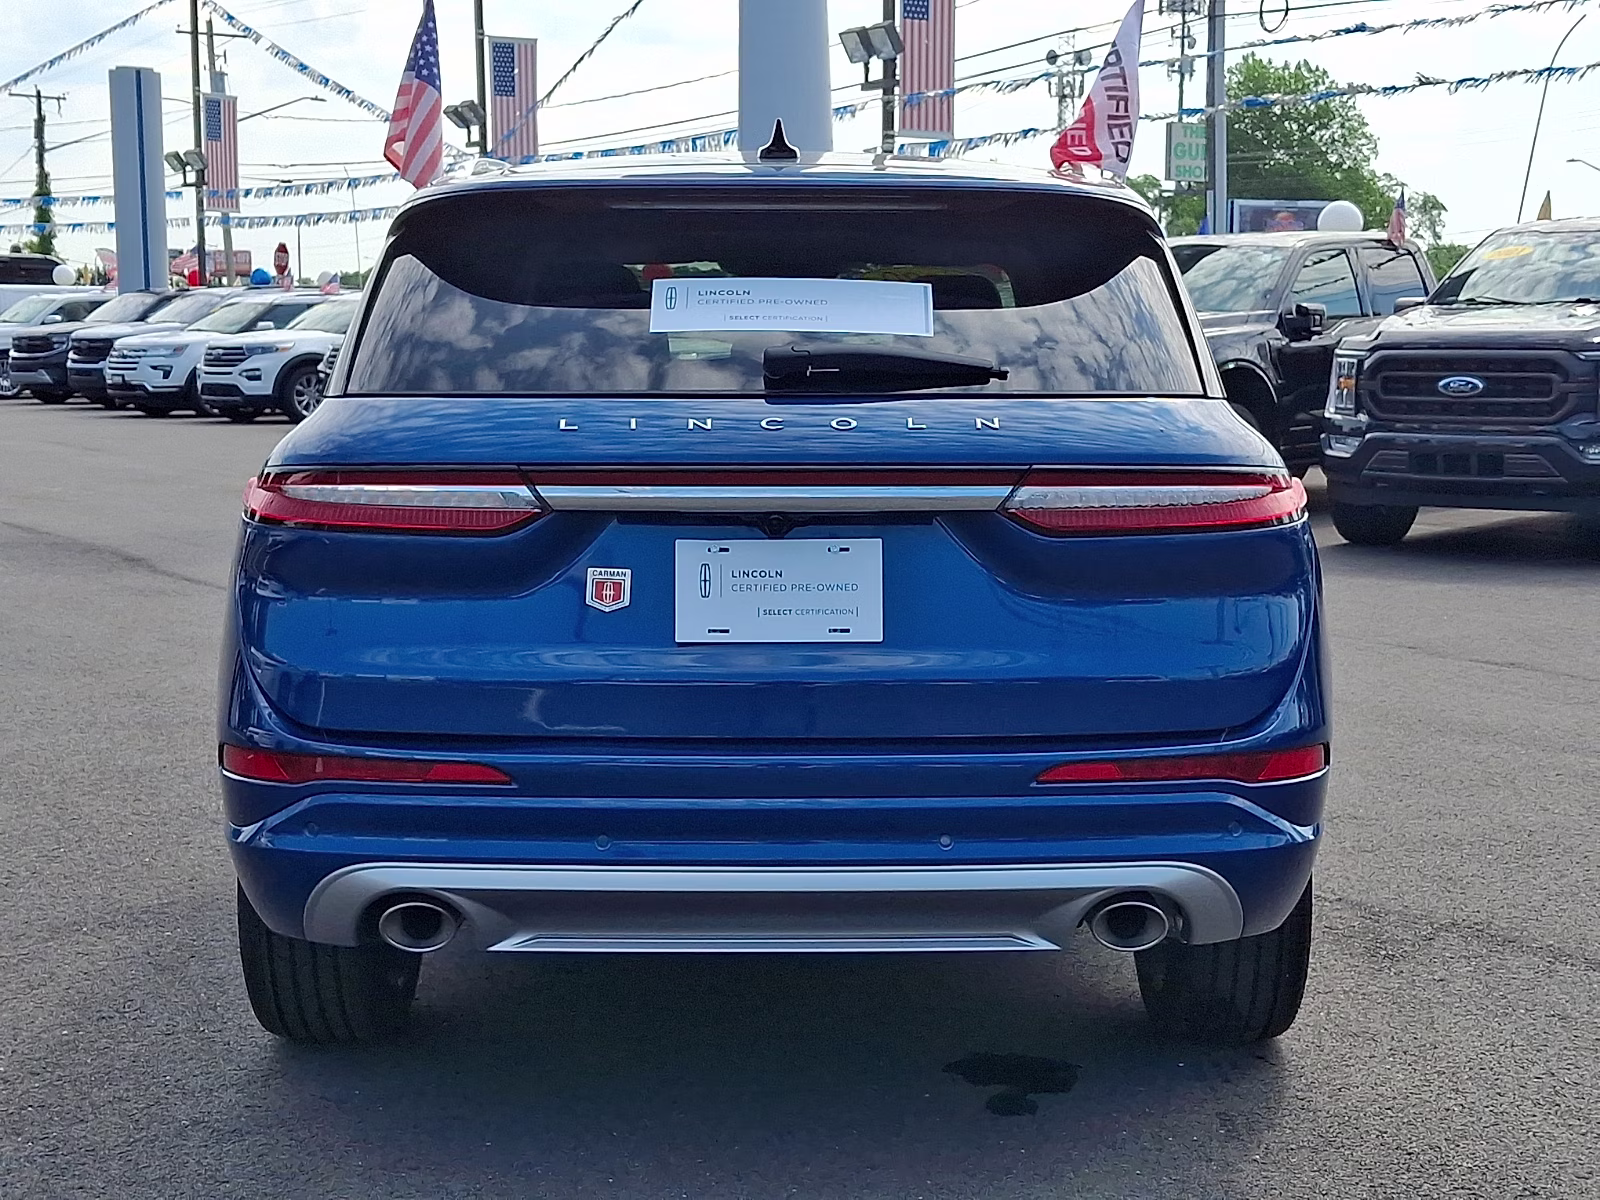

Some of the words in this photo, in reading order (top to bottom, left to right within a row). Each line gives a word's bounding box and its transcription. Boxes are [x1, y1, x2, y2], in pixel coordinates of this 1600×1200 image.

[1100, 40, 1132, 163] RTIFIED
[1175, 165, 1203, 179] SHO
[559, 417, 1000, 430] LINCOLN
[592, 569, 627, 577] CARMAN
[731, 569, 783, 578] LINCOLN
[731, 583, 787, 592] CERTIFIED
[790, 583, 859, 592] PRE-OWNED
[762, 608, 793, 616] SELECT
[794, 608, 854, 616] CERTIFICATION
